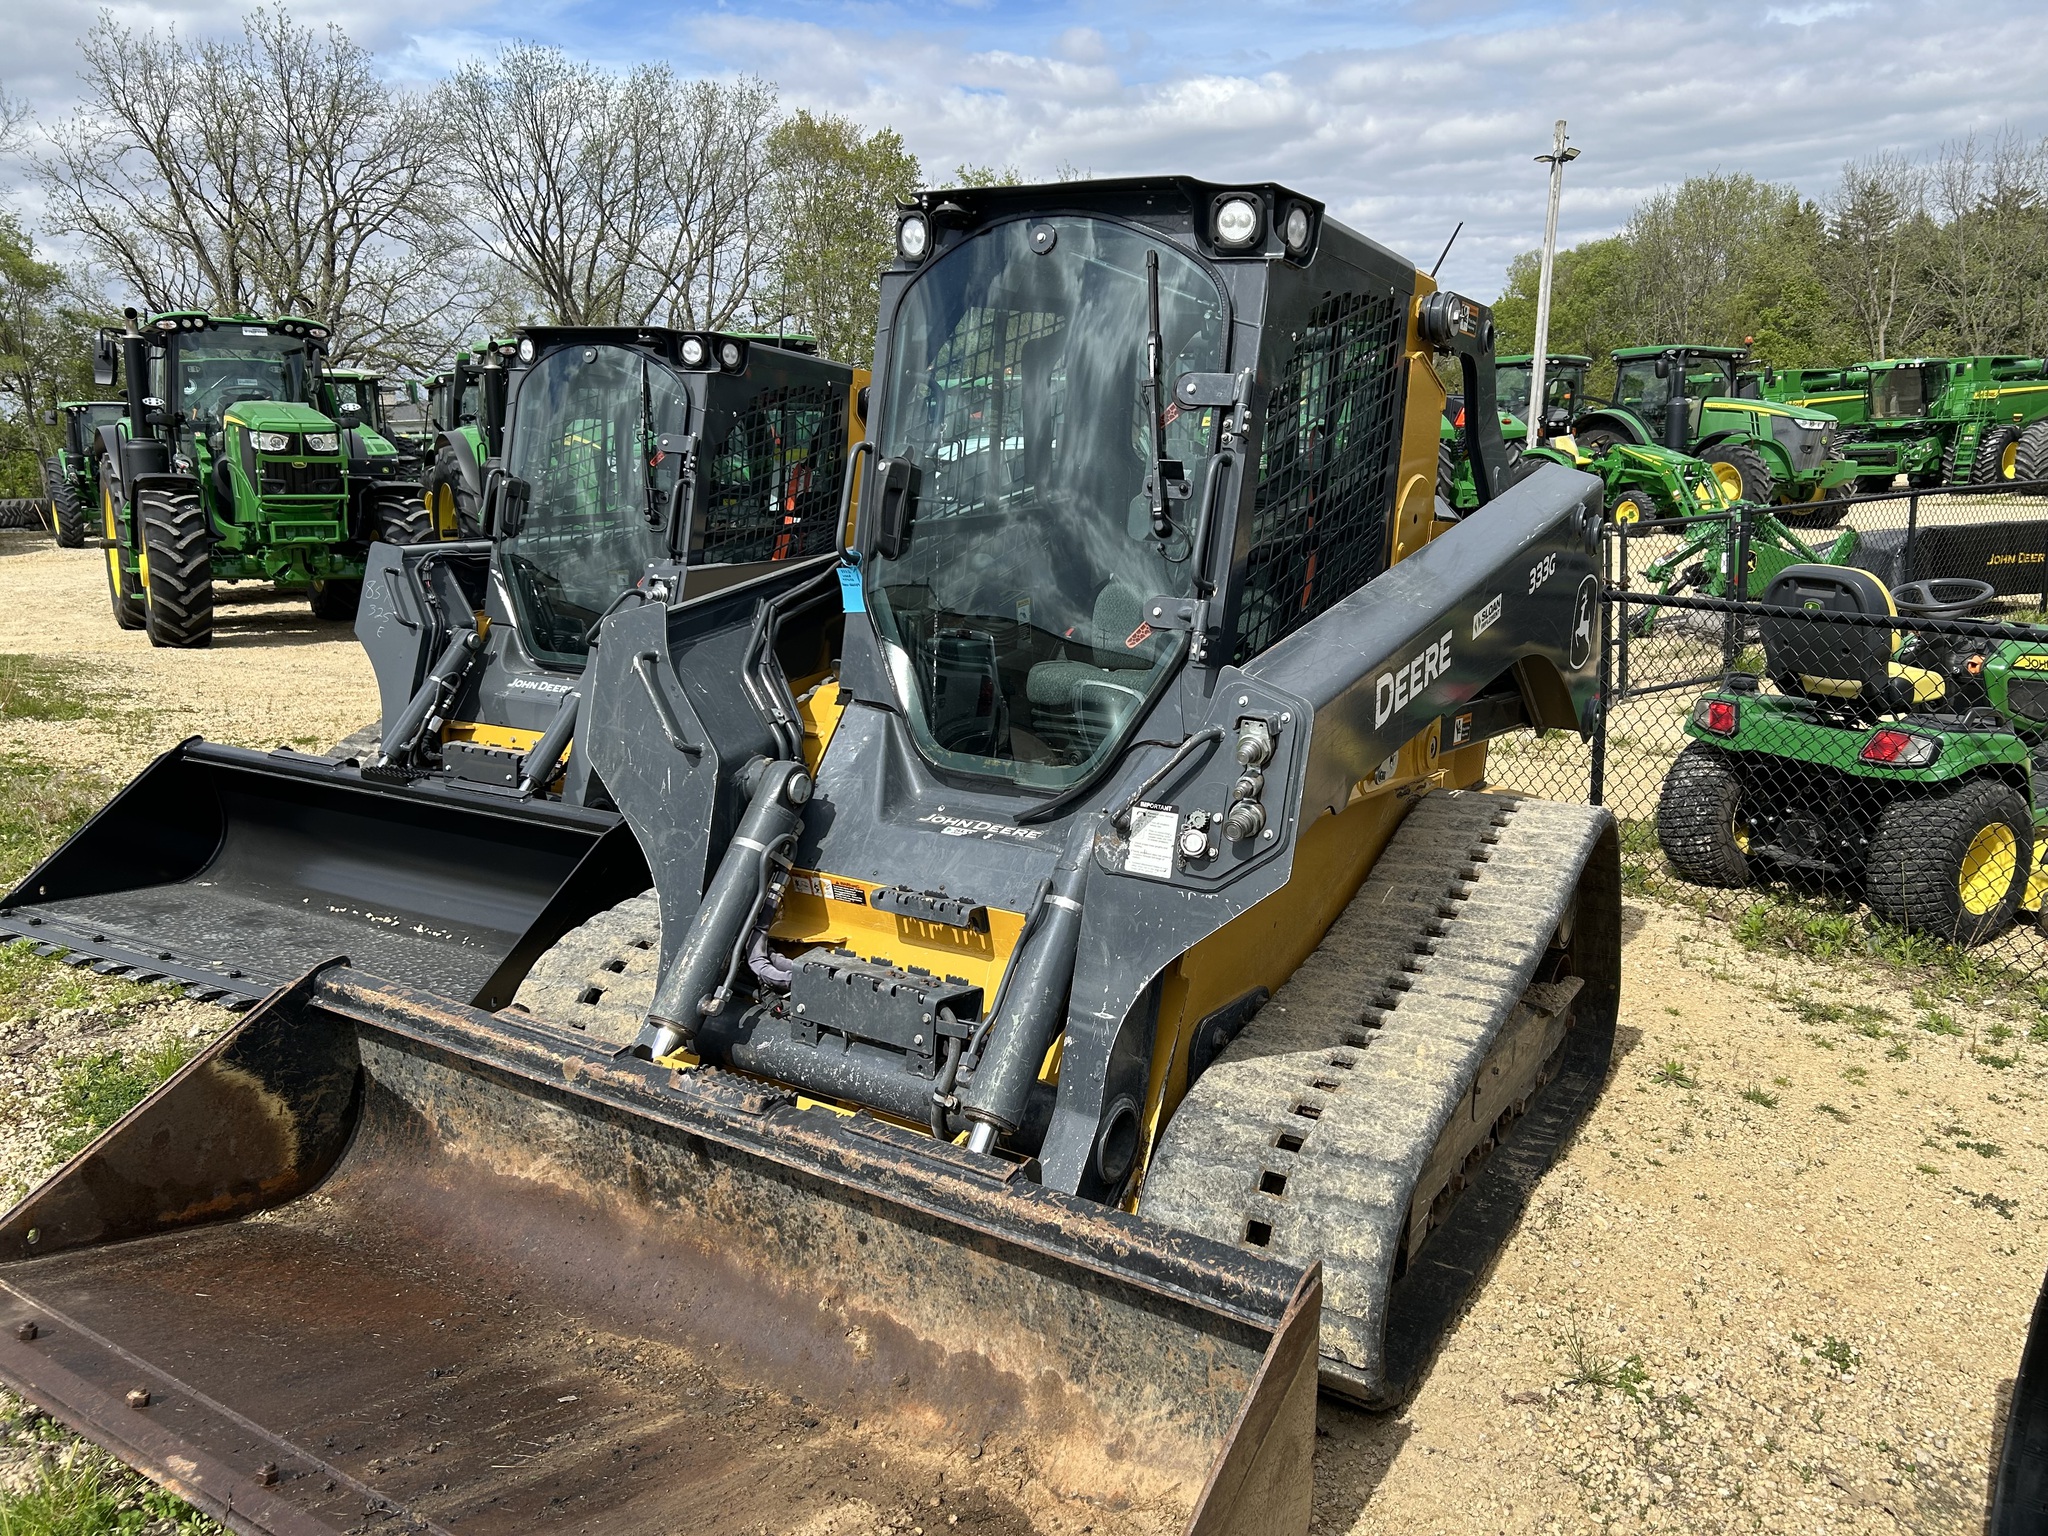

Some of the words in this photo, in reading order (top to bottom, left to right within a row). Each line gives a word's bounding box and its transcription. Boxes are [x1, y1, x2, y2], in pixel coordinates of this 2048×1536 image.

[1986, 553, 2016, 565] JOHN
[2018, 552, 2046, 563] DEER
[1528, 552, 1556, 595] 333G
[368, 604, 394, 623] 325
[1481, 597, 1501, 622] SLOAN
[507, 678, 538, 690] JOHN
[1375, 629, 1453, 730] DEERE
[1140, 801, 1173, 812] IMPORTANT
[917, 813, 976, 828] JOHN
[974, 820, 1042, 839] DEERE
